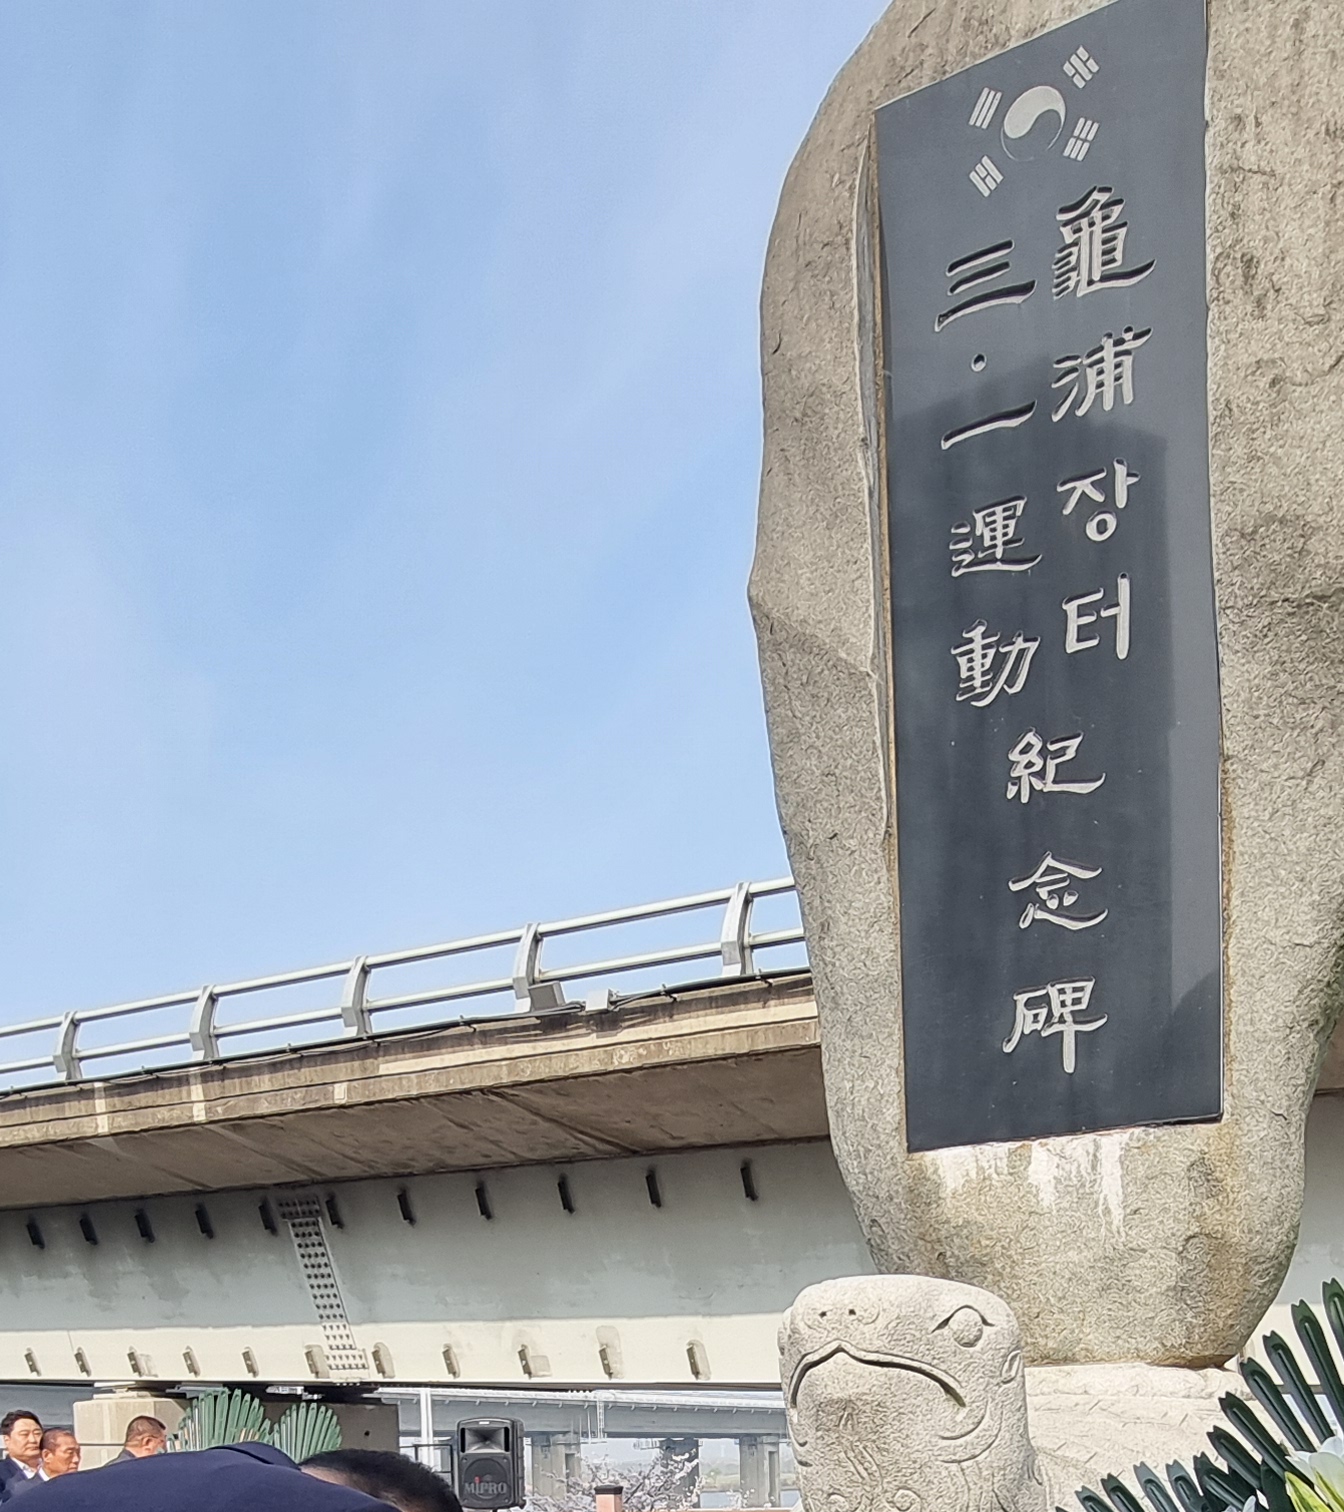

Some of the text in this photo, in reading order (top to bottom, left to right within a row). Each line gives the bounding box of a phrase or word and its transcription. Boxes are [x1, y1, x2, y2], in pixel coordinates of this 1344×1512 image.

[1052, 186, 1156, 660] 龜浦장터
[1002, 727, 1108, 1074] 紀念碑
